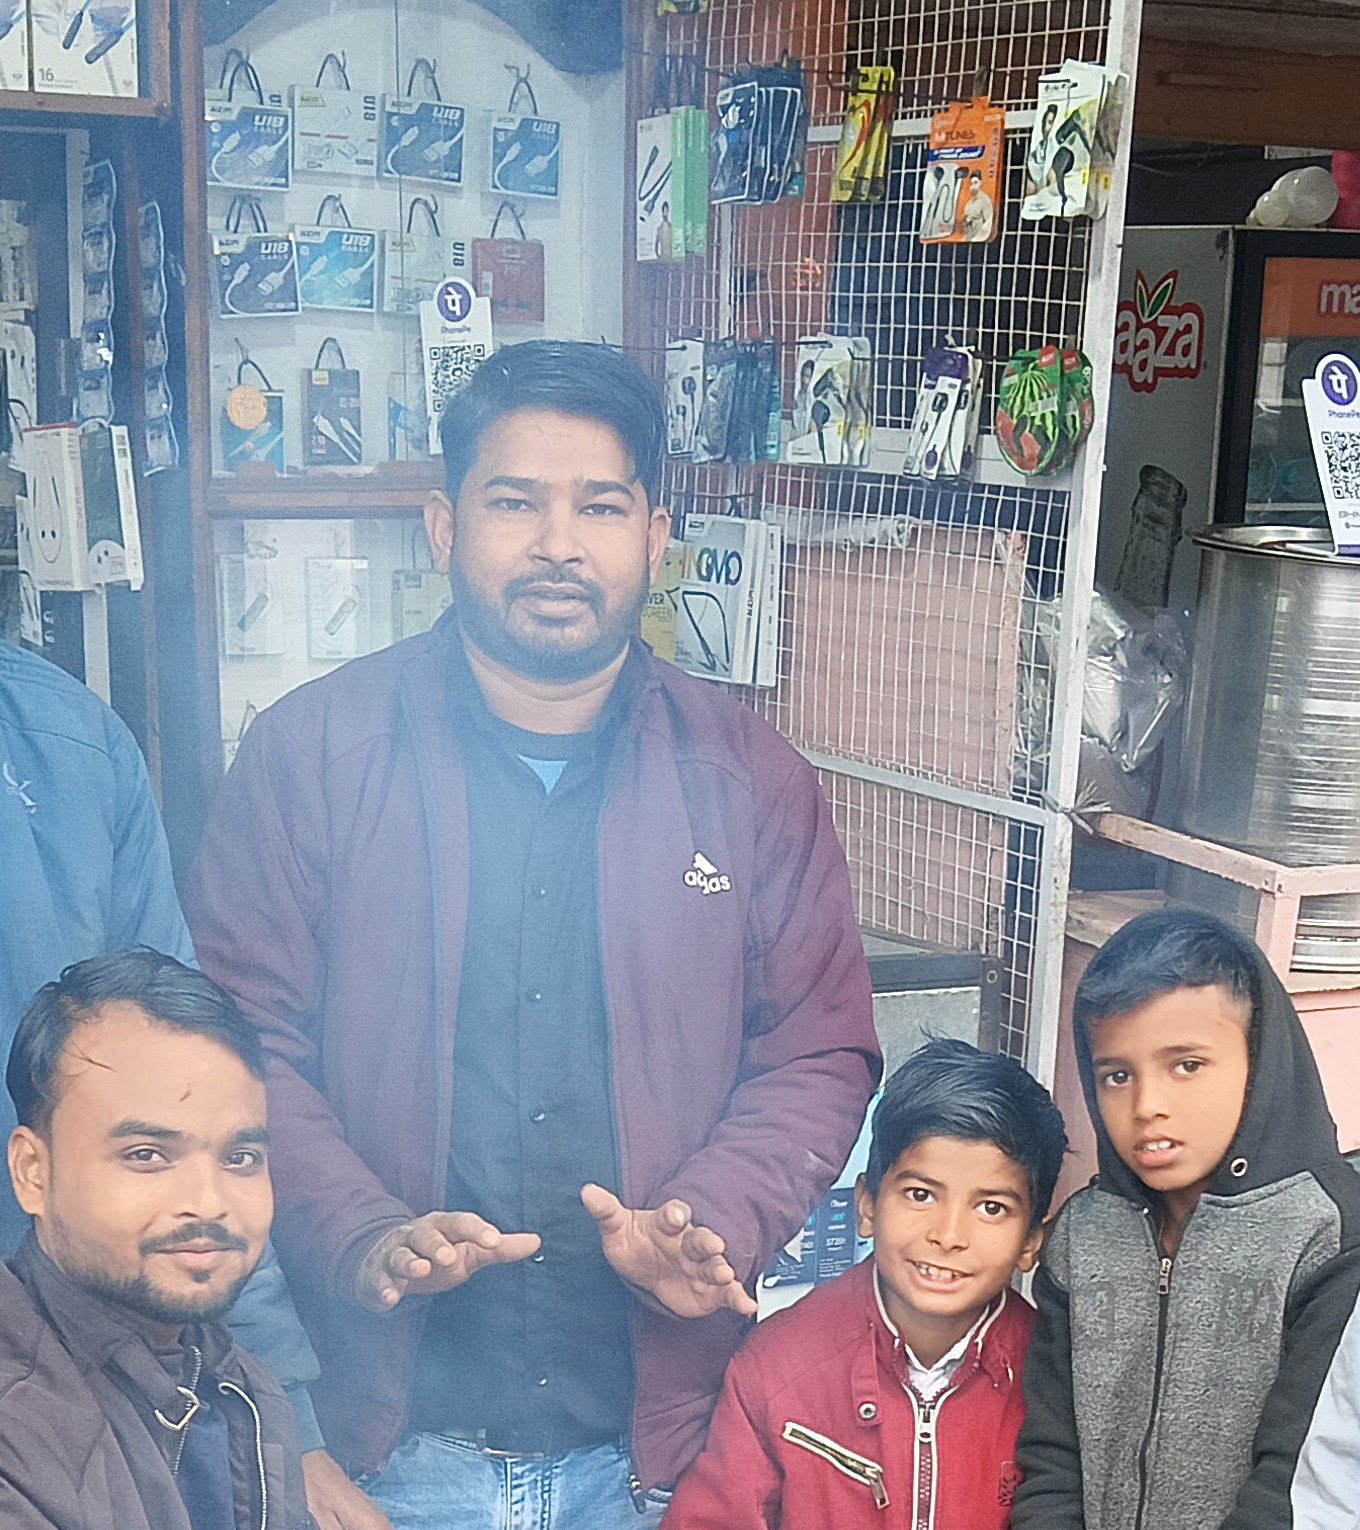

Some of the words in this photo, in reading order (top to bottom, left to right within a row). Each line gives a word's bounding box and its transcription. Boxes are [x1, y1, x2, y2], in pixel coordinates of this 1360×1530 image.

[39, 67, 54, 82] 16
[432, 106, 461, 120] U18
[254, 115, 285, 127] U18
[341, 234, 372, 246] U18
[260, 242, 289, 254] U18
[453, 242, 465, 267] U18
[444, 286, 463, 316] पे
[1115, 310, 1199, 384] aaza
[1329, 365, 1348, 399] पे
